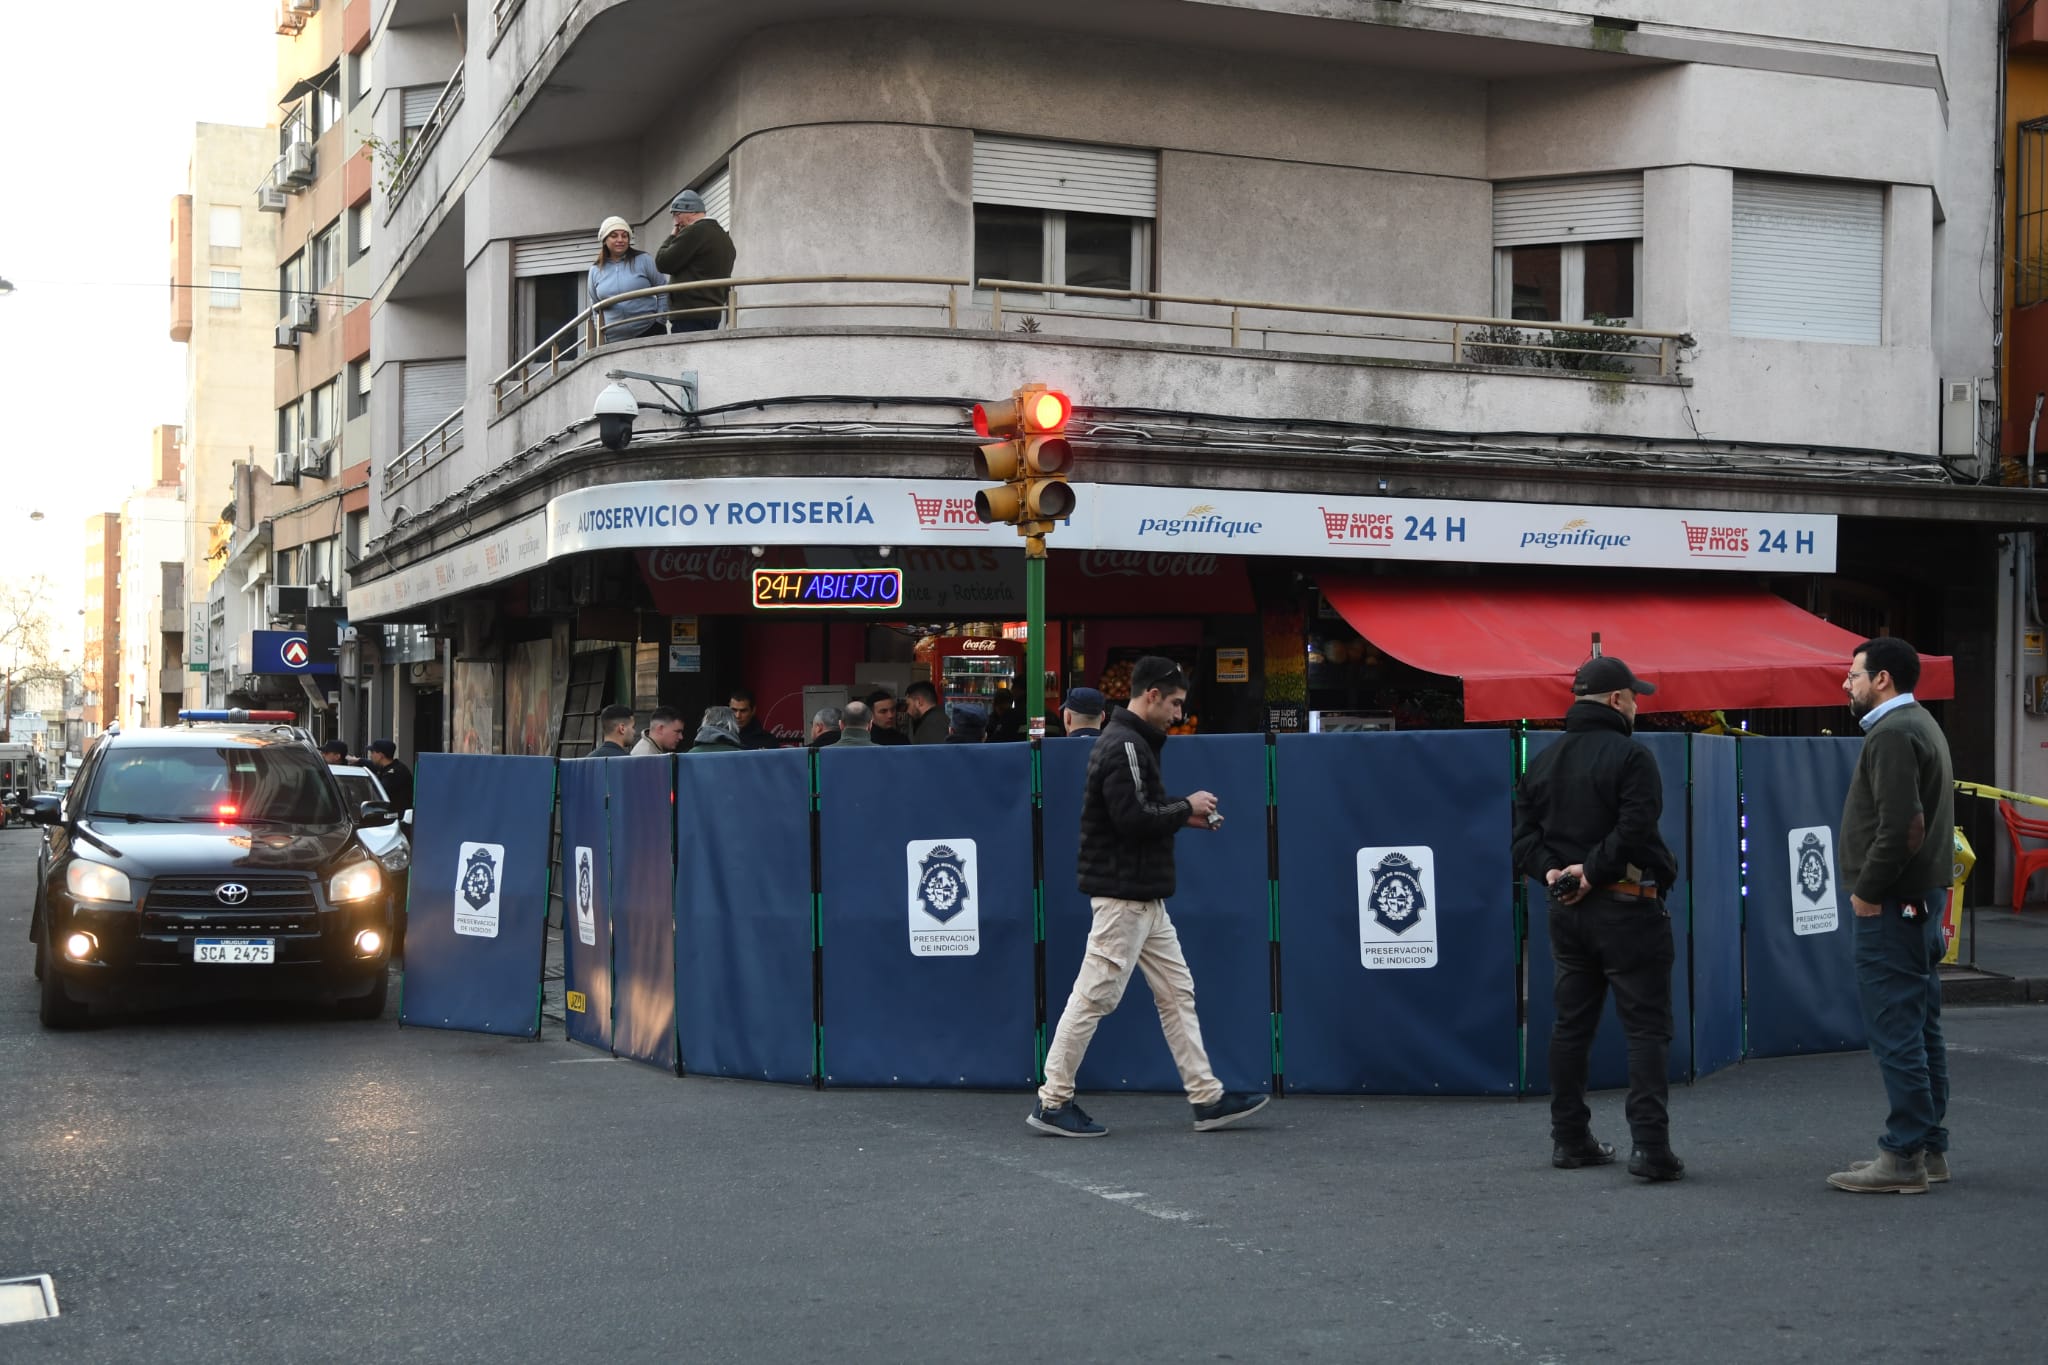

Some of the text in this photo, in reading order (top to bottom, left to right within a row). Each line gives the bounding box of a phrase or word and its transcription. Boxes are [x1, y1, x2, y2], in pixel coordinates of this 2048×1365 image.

[945, 498, 975, 511] sup
[578, 504, 698, 534] AUTOSERVICIO
[704, 504, 720, 525] Y
[727, 496, 874, 525] ROTISERÍA
[944, 509, 981, 525] ma
[1351, 513, 1393, 526] super
[1138, 515, 1262, 539] pagnifique
[1350, 516, 1466, 542] mas 24 H
[1711, 526, 1748, 539] super
[1519, 528, 1631, 549] pagnifique
[1709, 529, 1814, 554] mas 24 H
[757, 574, 897, 599] 24H ABIERTO
[1281, 716, 1297, 727] mas
[201, 946, 269, 961] SCA 2475
[920, 944, 969, 952] DE INDICIOS
